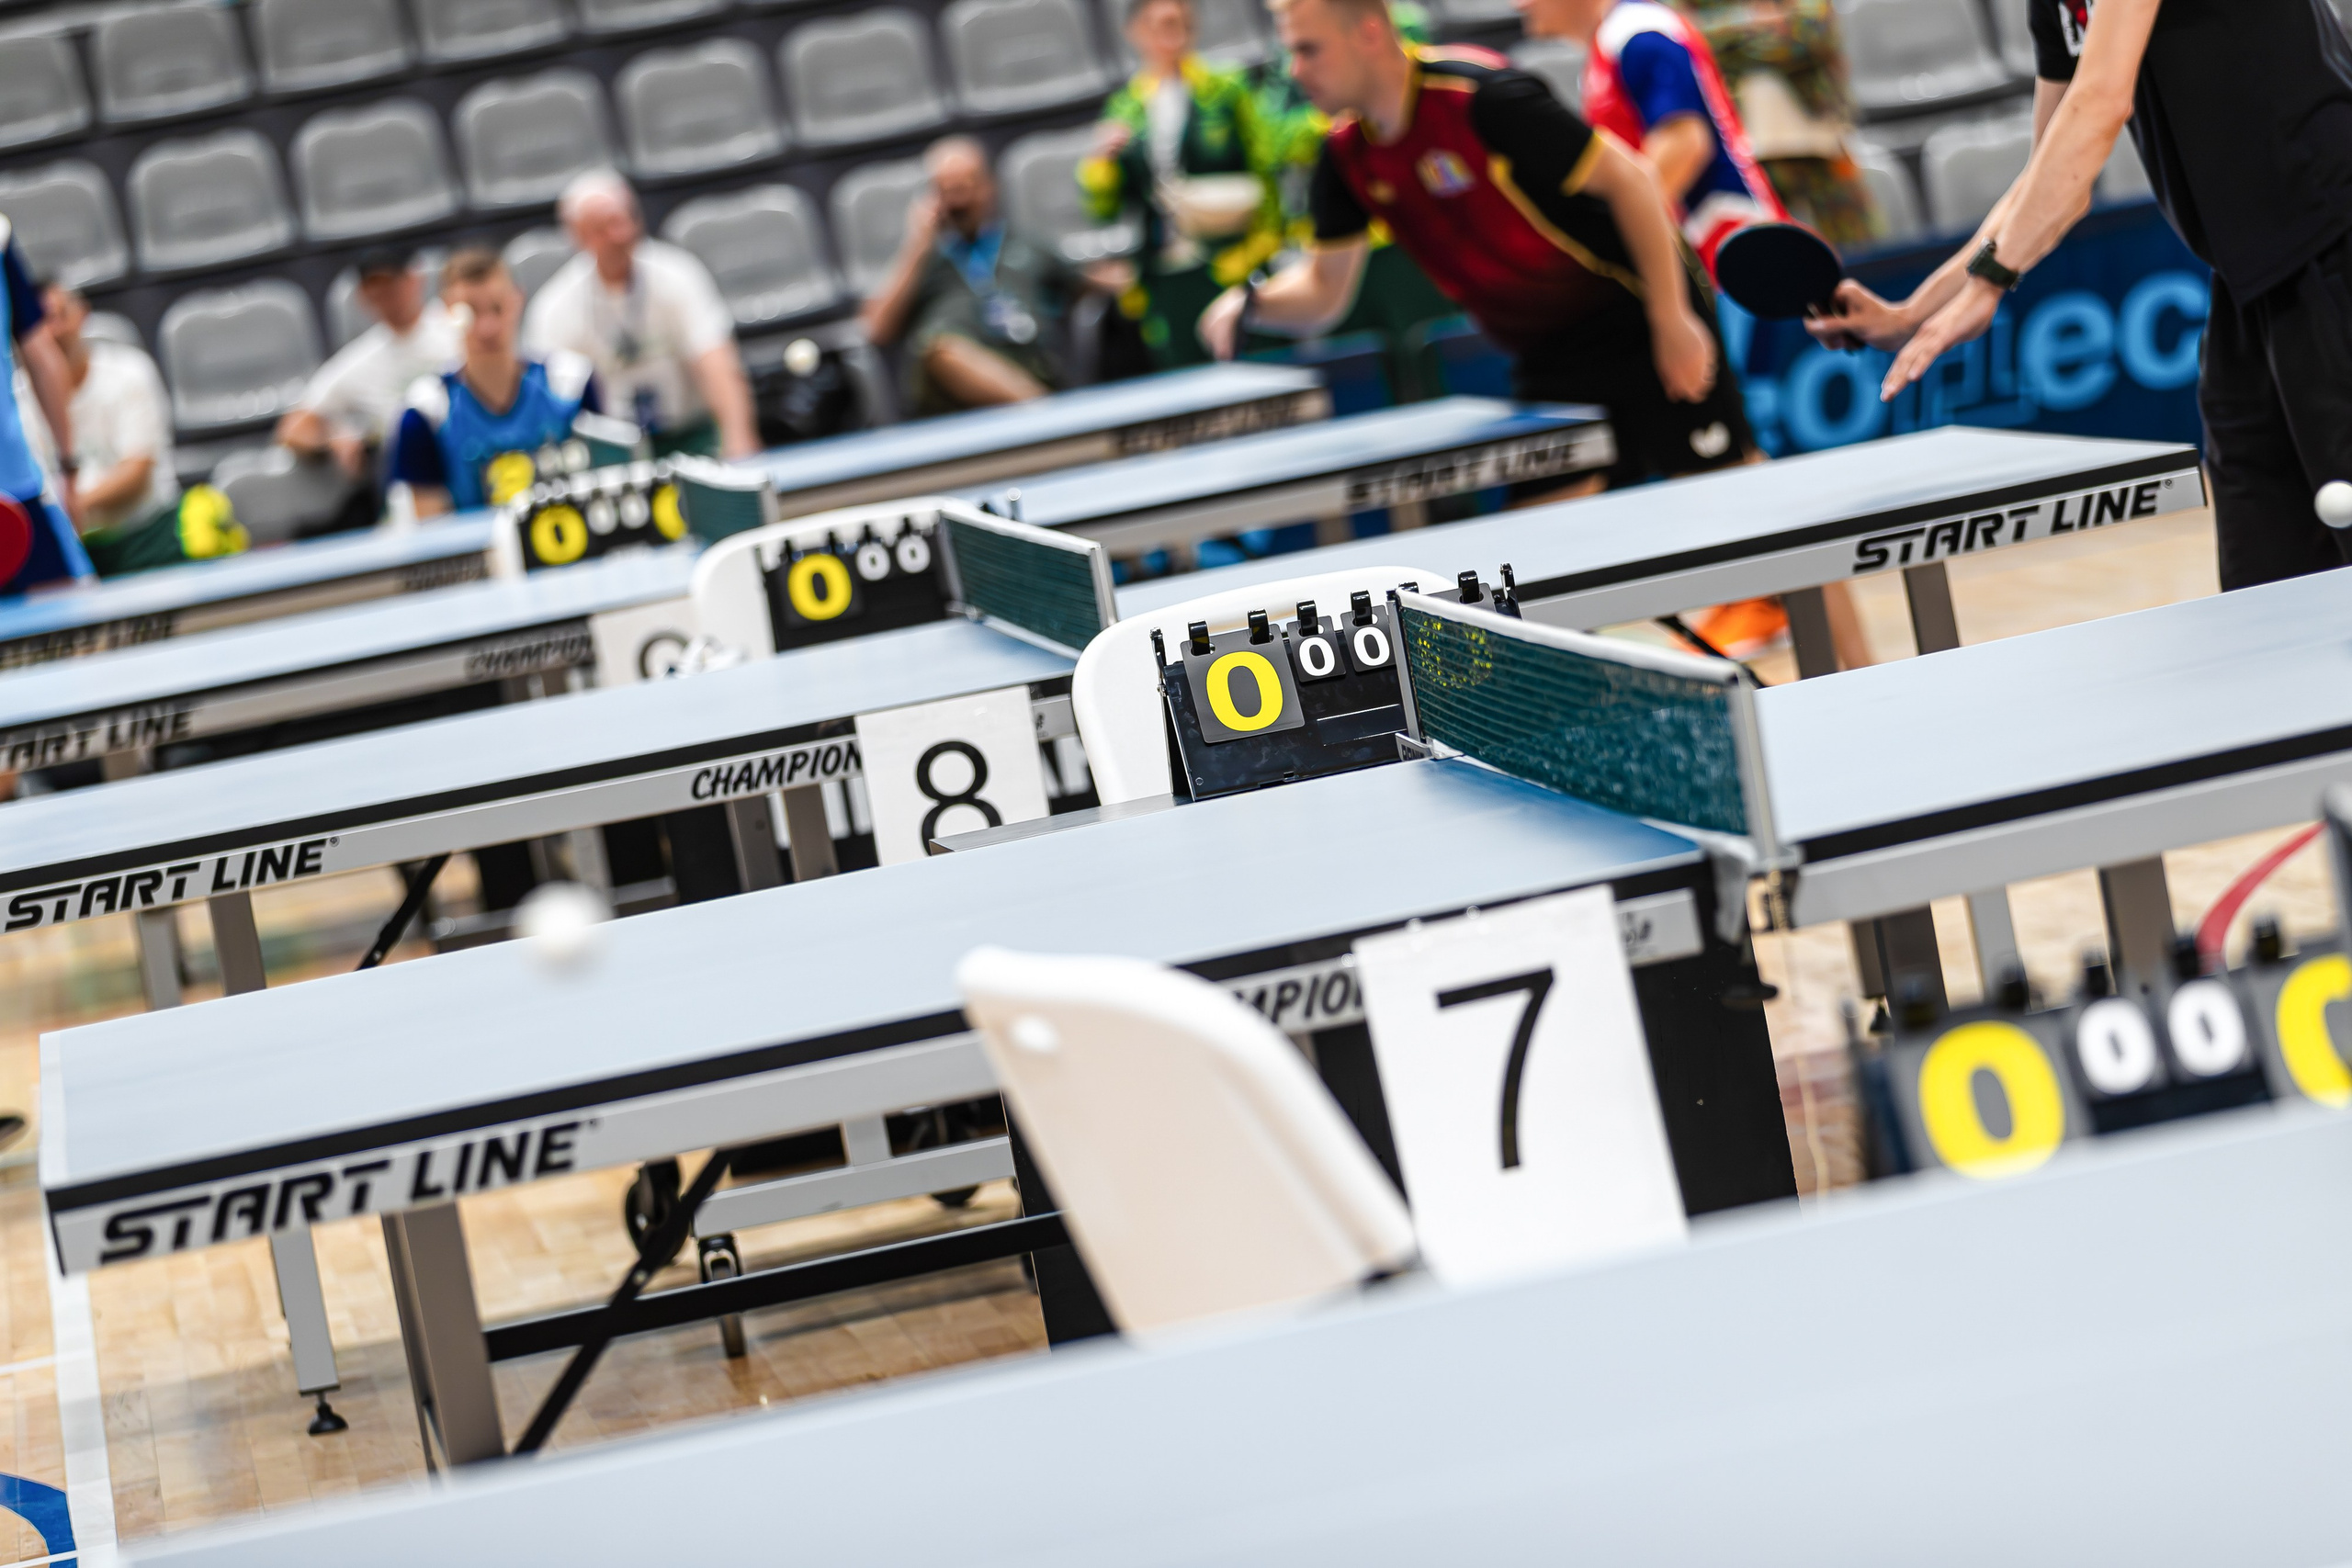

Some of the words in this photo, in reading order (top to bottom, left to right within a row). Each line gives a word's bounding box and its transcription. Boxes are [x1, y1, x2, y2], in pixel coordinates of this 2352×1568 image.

[787, 553, 853, 621] 0
[856, 541, 890, 581] 0
[897, 533, 930, 574] 0
[1852, 504, 2040, 573] START
[2051, 481, 2162, 536] LINE
[1205, 650, 1284, 733] 0
[1298, 636, 1337, 678] 0
[1352, 626, 1391, 667] 0
[691, 741, 863, 800] CHAMPION
[916, 739, 1002, 856] 8
[4, 861, 201, 933] START
[211, 839, 327, 894] LINE
[1436, 965, 1556, 1172] 7
[1918, 1021, 2065, 1180] 0
[2077, 998, 2159, 1095] 0
[2168, 980, 2248, 1078] 0
[99, 1159, 393, 1266] START
[410, 1120, 584, 1203] LINE
